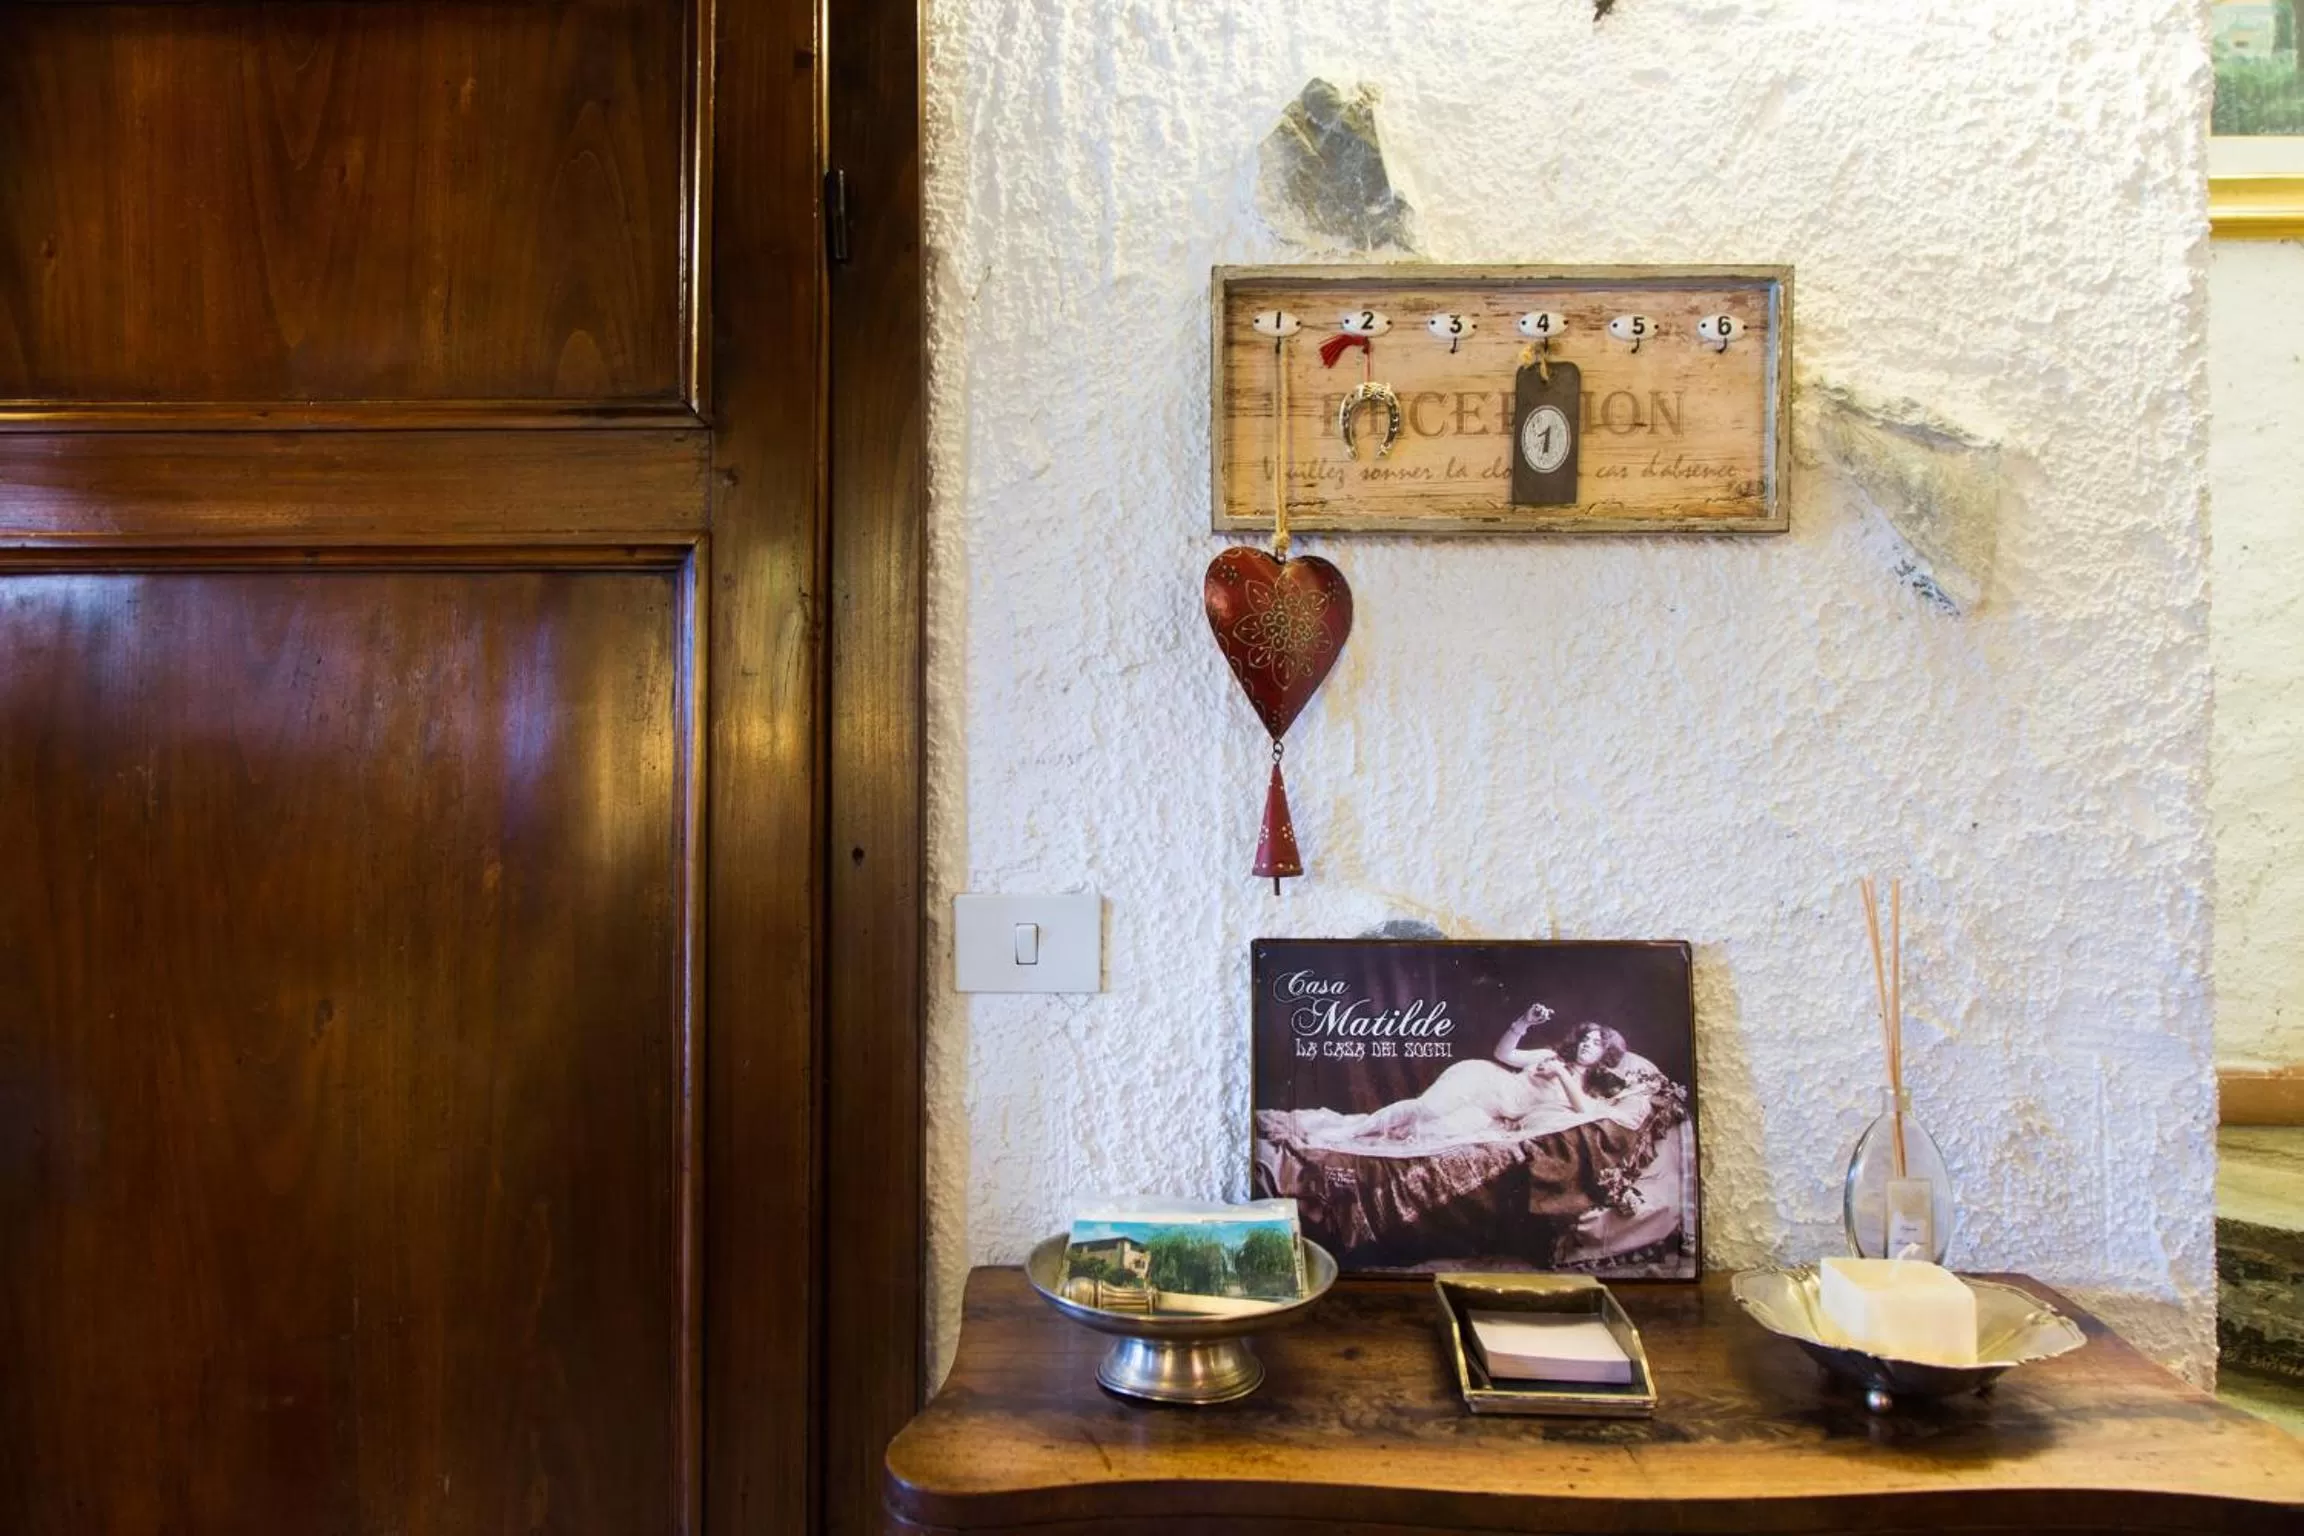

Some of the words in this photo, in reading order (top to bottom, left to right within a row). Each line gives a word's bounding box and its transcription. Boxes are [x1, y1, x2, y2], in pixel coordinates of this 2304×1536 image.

[1276, 311, 1282, 329] 1
[1361, 311, 1374, 330] 2
[1449, 314, 1462, 334] 3
[1536, 313, 1550, 333] 4
[1632, 316, 1645, 335] 5
[1717, 315, 1732, 336] 6
[1320, 390, 1687, 438] RCEION
[1537, 425, 1551, 455] 1
[1262, 455, 1345, 490] Vuillez
[1359, 464, 1434, 482] sonner
[1446, 455, 1470, 480] la
[1481, 455, 1513, 480] clo
[1595, 463, 1629, 479] cas
[1273, 969, 1351, 1004] Casa
[1291, 998, 1456, 1038] Matilde
[1295, 1037, 1319, 1062] LA
[1323, 1039, 1367, 1063] CASA
[1371, 1041, 1399, 1058] DEI
[1403, 1042, 1453, 1059] SOGNI
